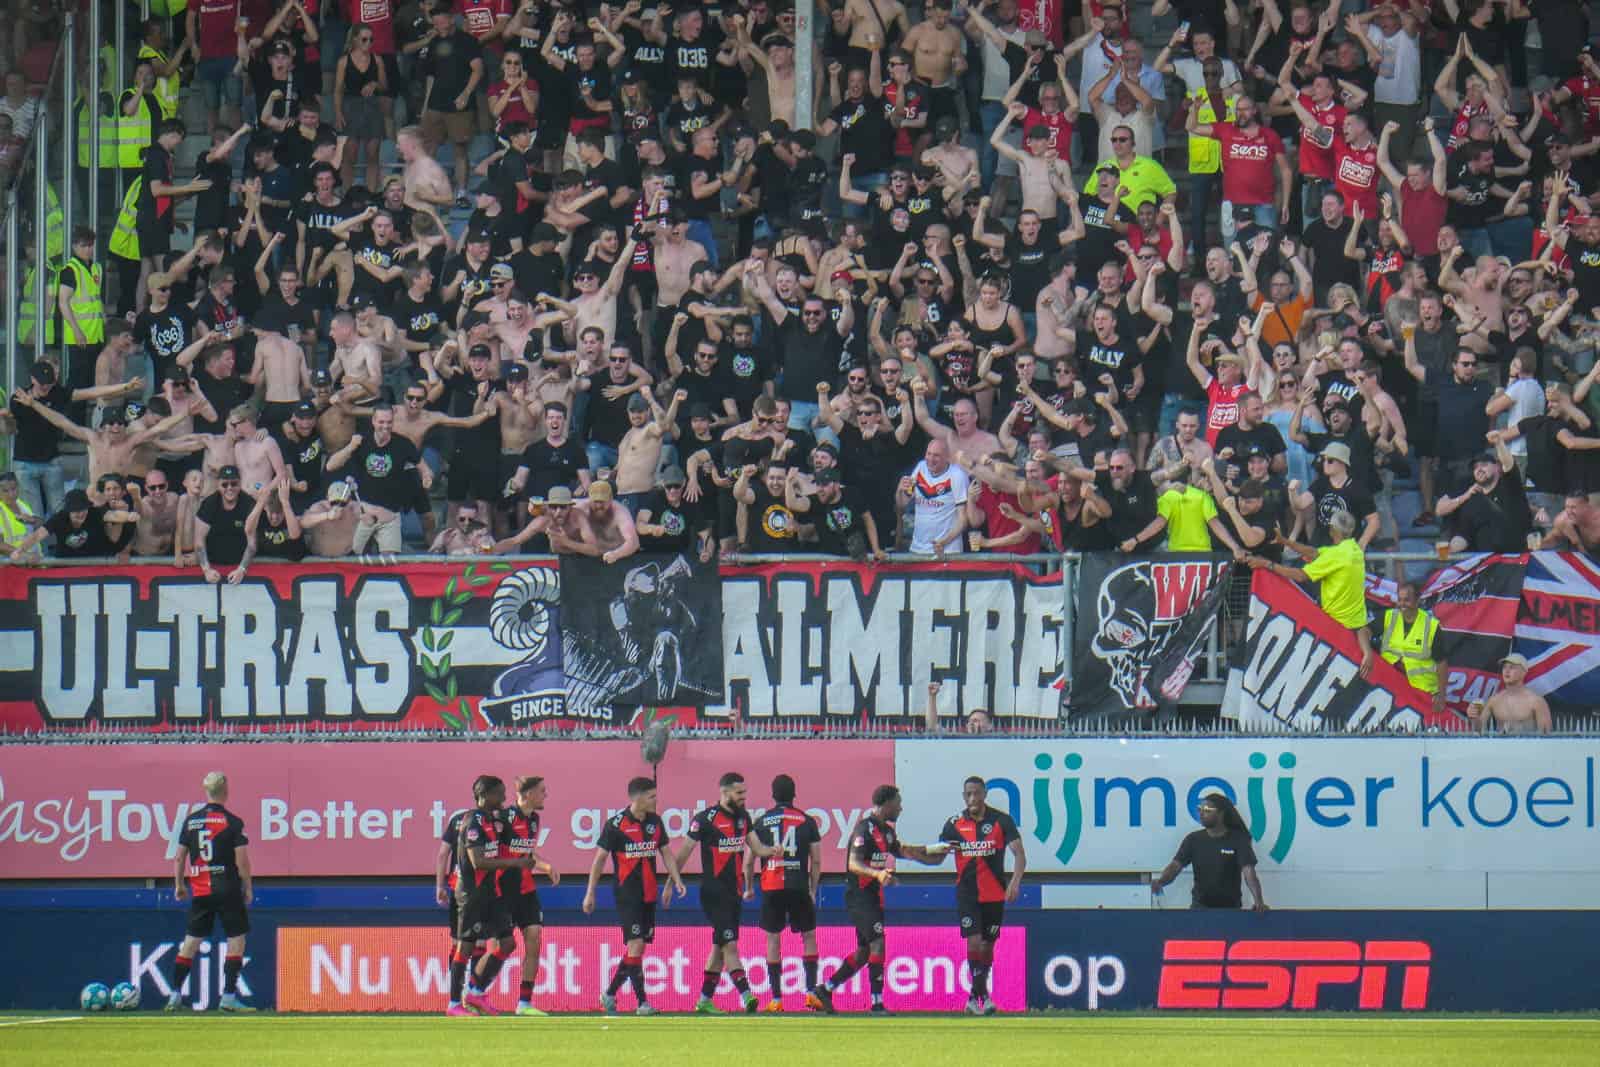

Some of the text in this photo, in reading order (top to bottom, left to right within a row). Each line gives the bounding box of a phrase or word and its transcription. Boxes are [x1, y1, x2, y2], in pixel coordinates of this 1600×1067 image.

[634, 47, 665, 63] ALLY
[678, 47, 708, 68] 036
[1090, 346, 1125, 368] ALLY
[36, 579, 409, 718] ULTRAS
[705, 577, 1064, 719] ALMERE
[511, 698, 564, 720] SINCE
[1422, 756, 1594, 829] koel
[261, 798, 413, 841] Better
[199, 830, 213, 862] 5
[769, 825, 798, 857] 14
[310, 943, 391, 994] Nu
[1044, 954, 1126, 1010] op
[1157, 940, 1432, 1009] ESPN
